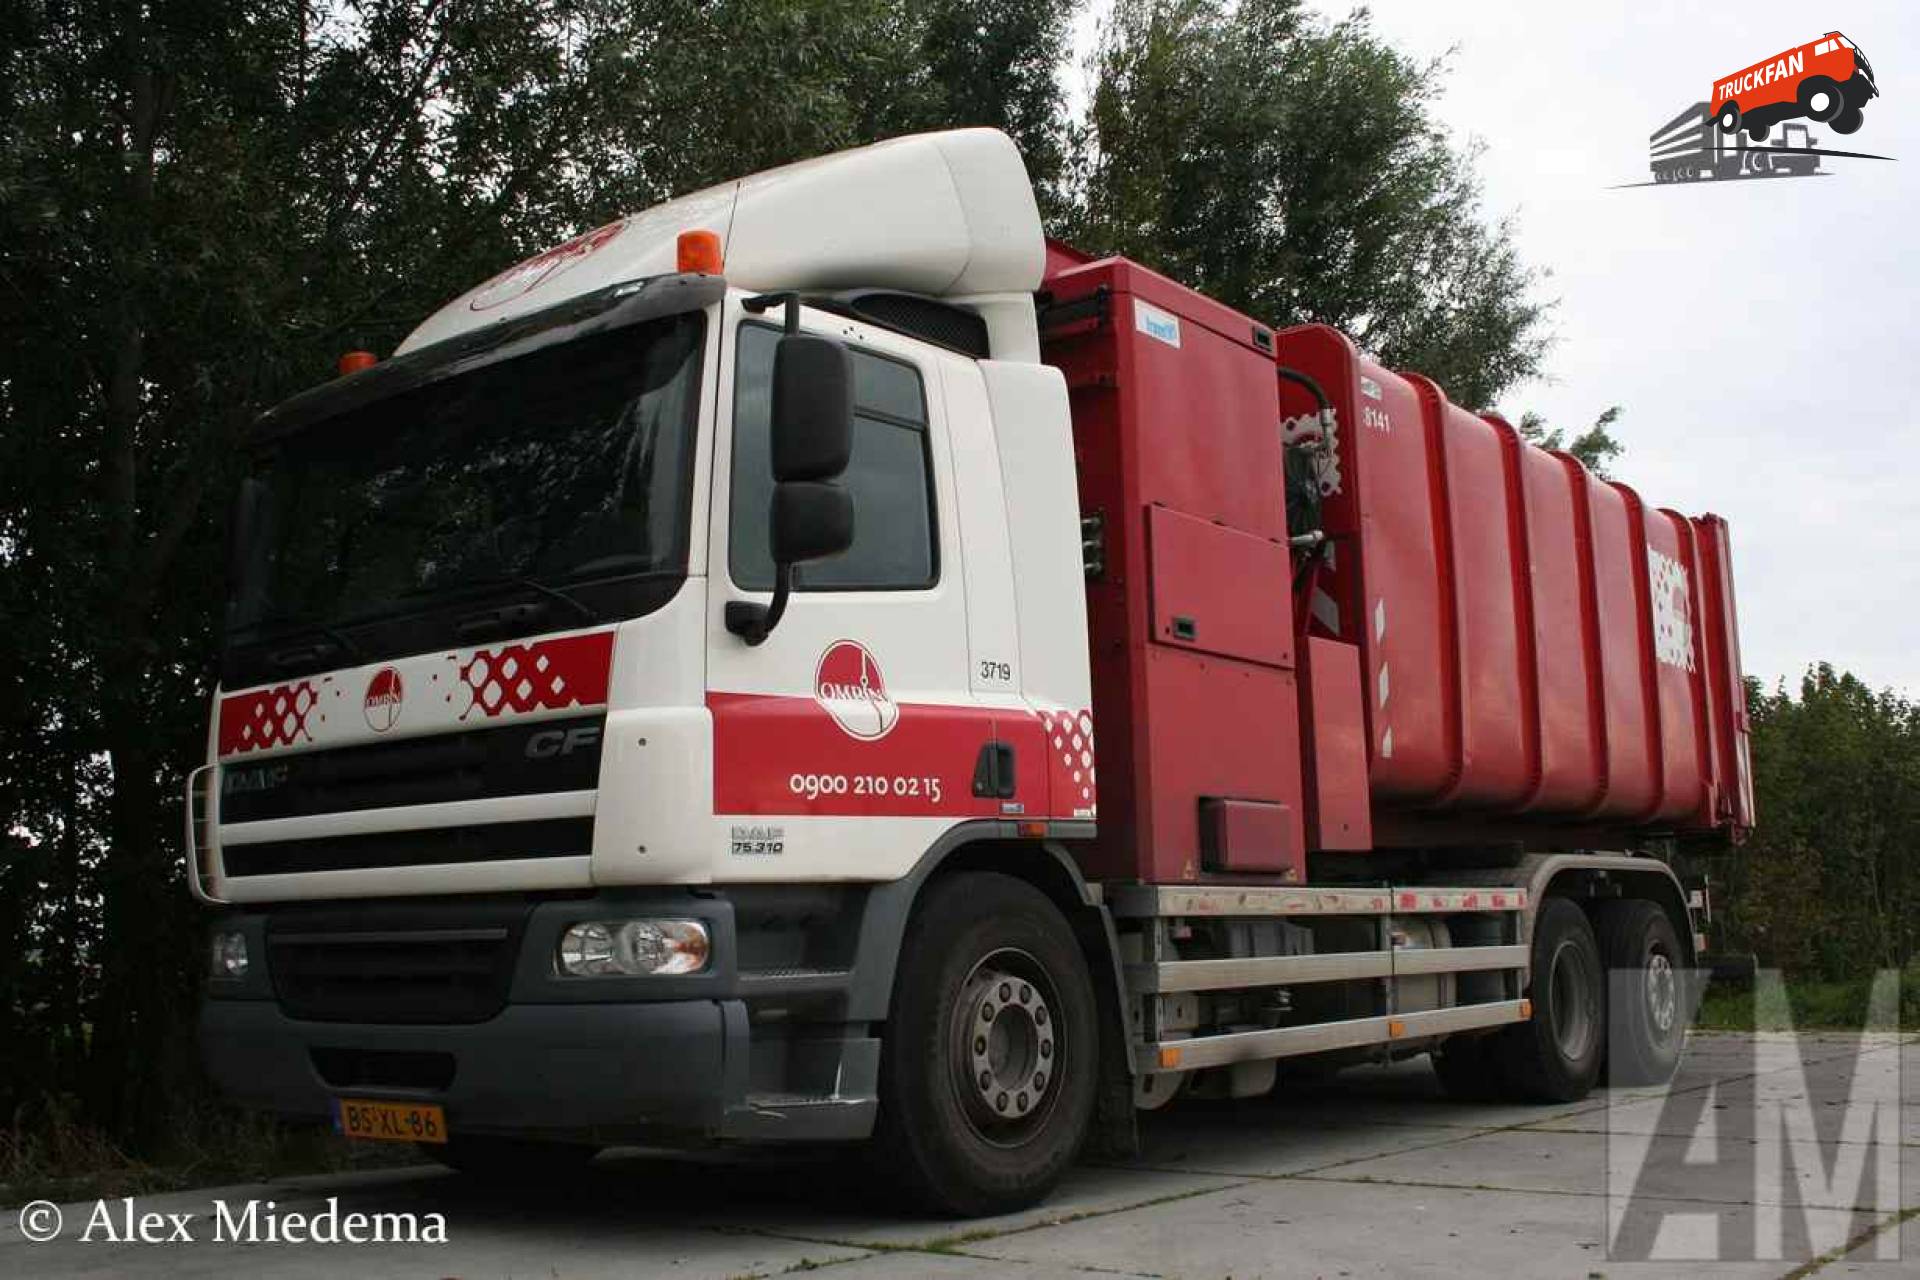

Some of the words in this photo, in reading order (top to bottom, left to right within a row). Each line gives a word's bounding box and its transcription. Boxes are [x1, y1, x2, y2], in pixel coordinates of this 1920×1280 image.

[981, 661, 1011, 682] 3719
[524, 725, 599, 759] CF
[790, 773, 847, 800] 0900
[853, 774, 888, 795] 210
[894, 777, 919, 798] 02
[924, 778, 941, 802] 15
